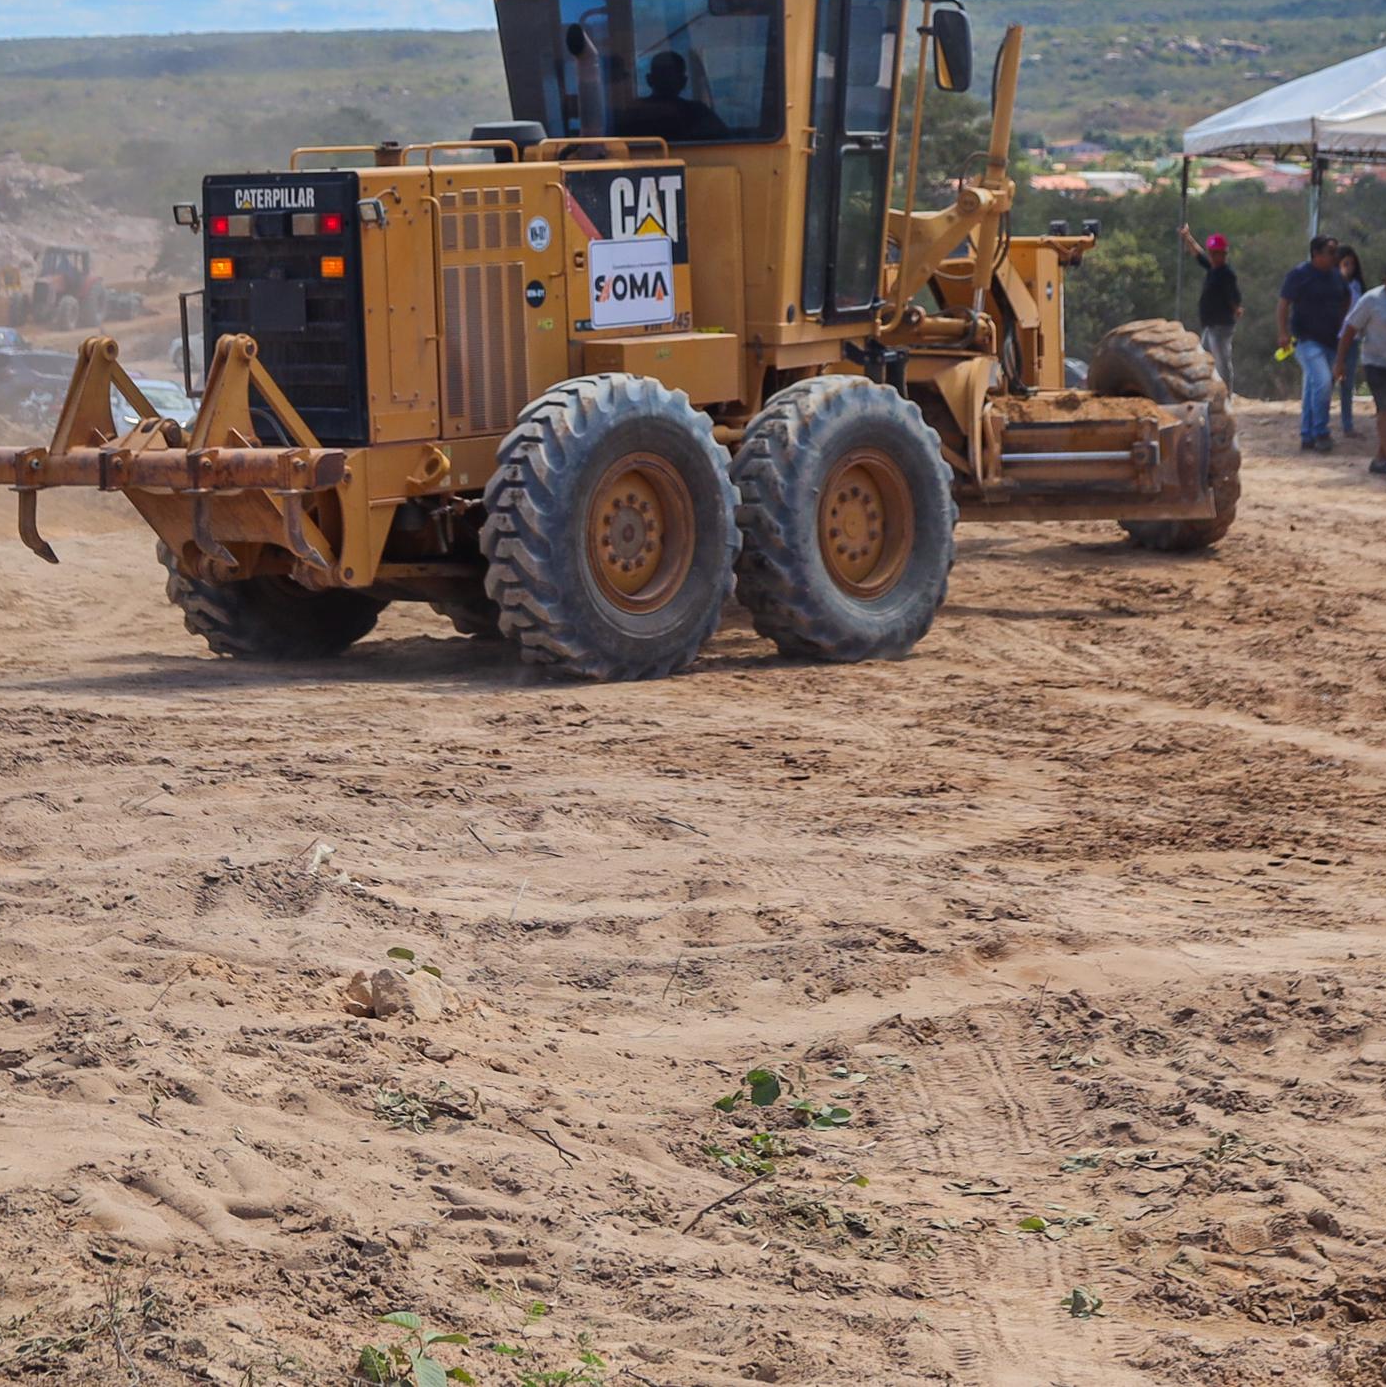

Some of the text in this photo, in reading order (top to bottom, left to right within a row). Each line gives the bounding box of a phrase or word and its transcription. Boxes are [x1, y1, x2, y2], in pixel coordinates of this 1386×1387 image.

[235, 187, 315, 209] CATERPILLAR
[610, 175, 682, 243] CAT
[595, 271, 668, 303] SOMA
